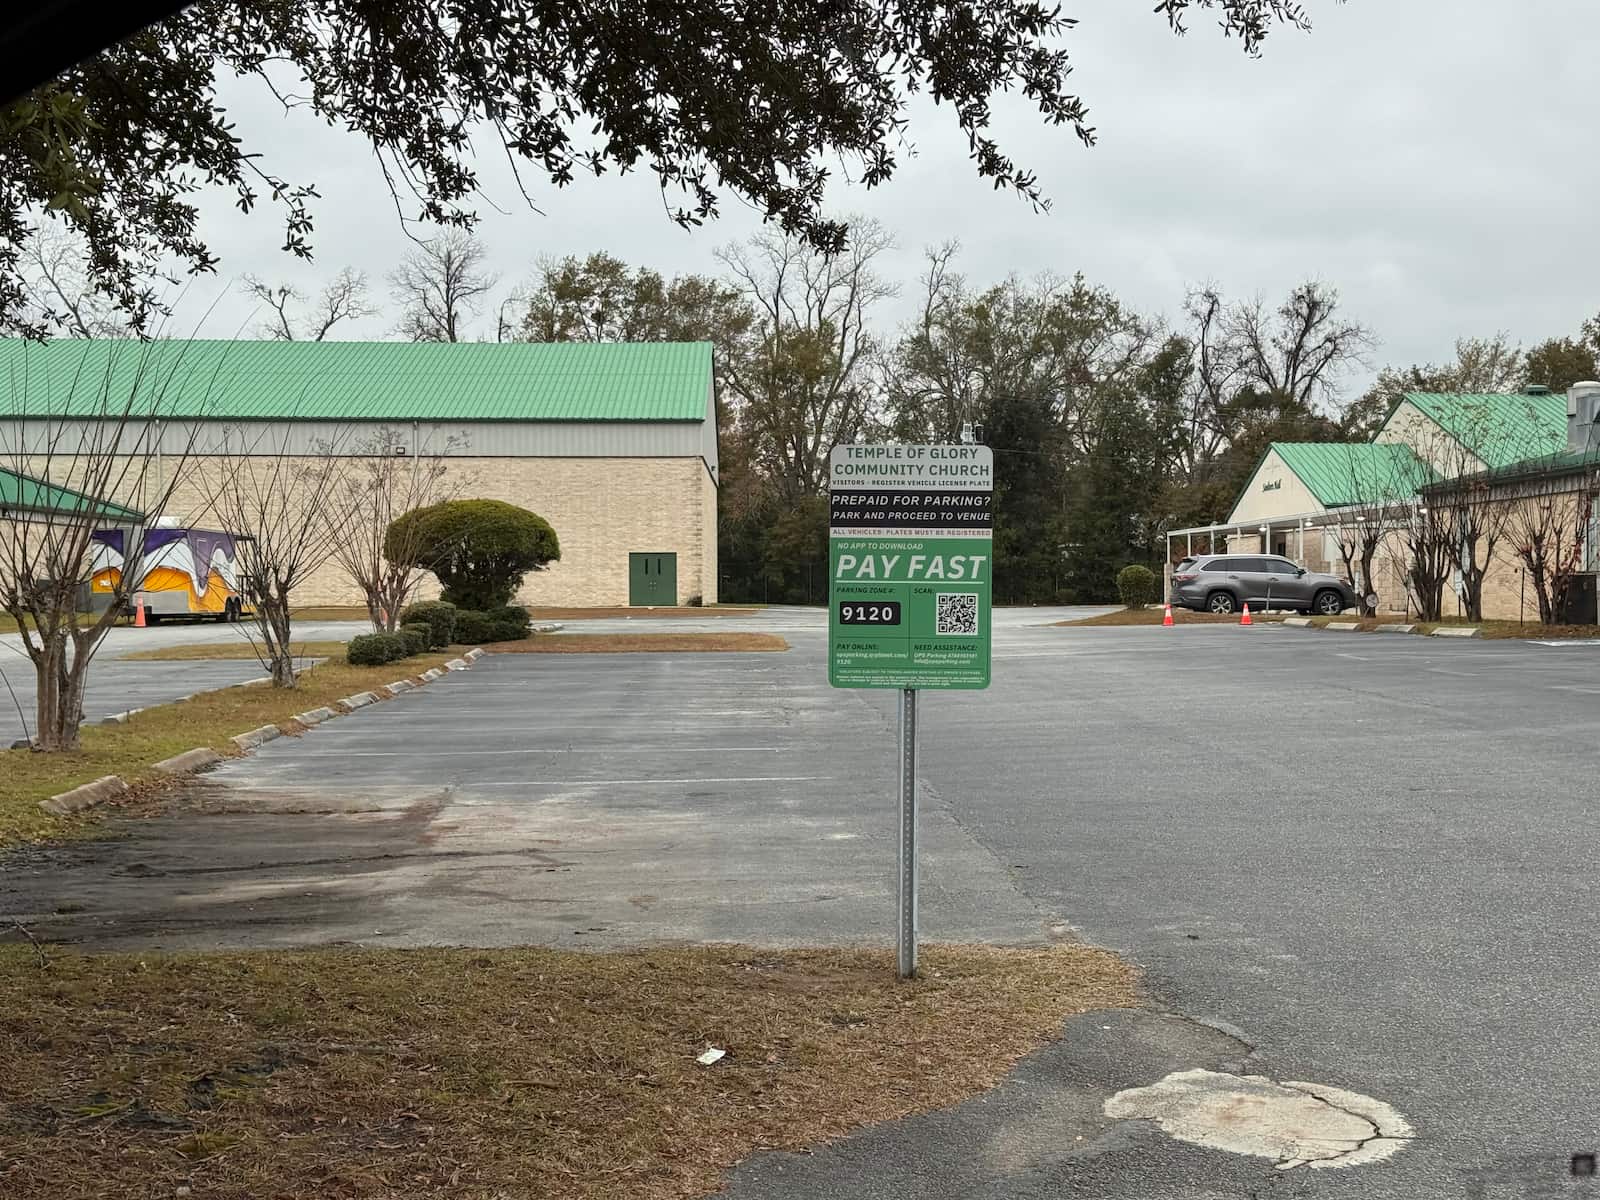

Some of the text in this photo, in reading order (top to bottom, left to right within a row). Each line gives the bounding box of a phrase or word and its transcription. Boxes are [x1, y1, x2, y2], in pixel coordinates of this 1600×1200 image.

[847, 447, 979, 459] TEMPLE OF GLORY
[834, 464, 989, 476] COMMUNITY CHURCH
[832, 495, 991, 506] PREPAID FOR PARKING?
[832, 511, 991, 521] PARK AND PROCEED TO VENUE
[836, 554, 986, 579] PAY FAST
[842, 607, 893, 621] 9120
